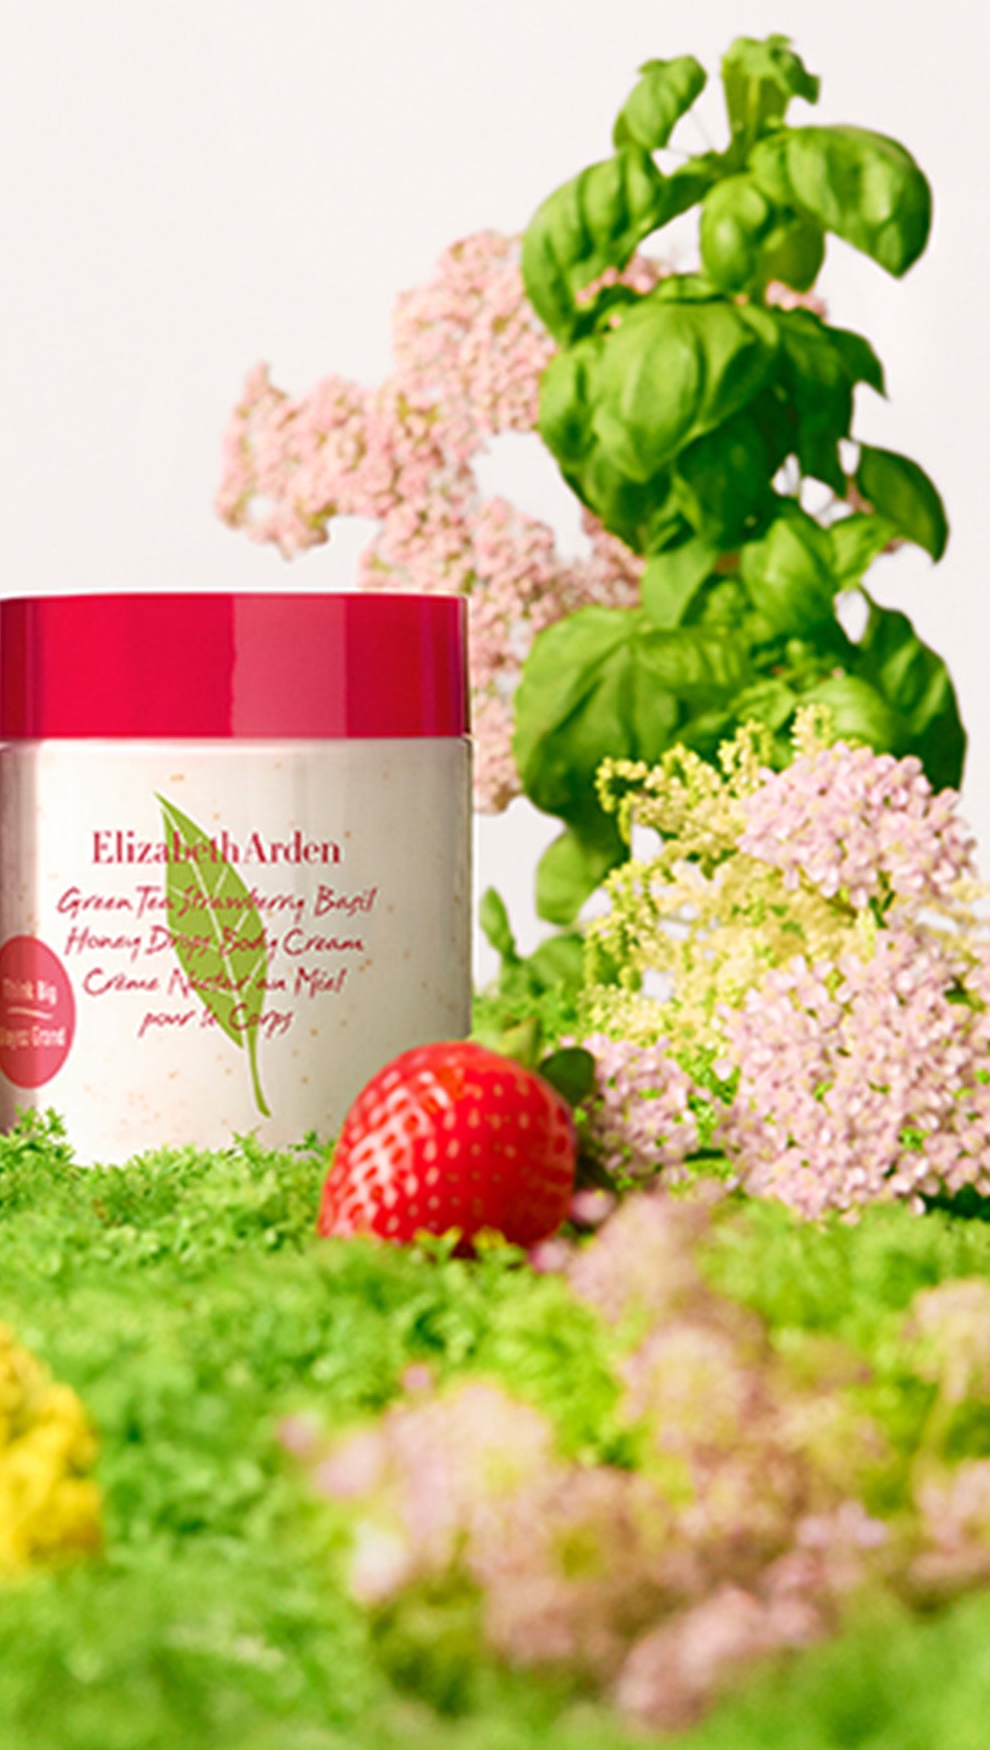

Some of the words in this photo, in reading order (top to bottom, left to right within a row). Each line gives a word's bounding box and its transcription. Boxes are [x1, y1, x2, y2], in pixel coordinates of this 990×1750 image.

[56, 886, 132, 918] Green
[136, 885, 173, 918] Tea
[177, 884, 305, 924] Strawberry
[314, 884, 378, 917] Basil
[64, 926, 142, 961] Honey
[219, 925, 278, 961] Body
[283, 928, 365, 956] Cream
[167, 967, 250, 998] Nectar
[256, 973, 287, 992] au
[294, 967, 348, 998] Miel
[137, 1010, 196, 1038] pour
[227, 1003, 295, 1038] Corps
